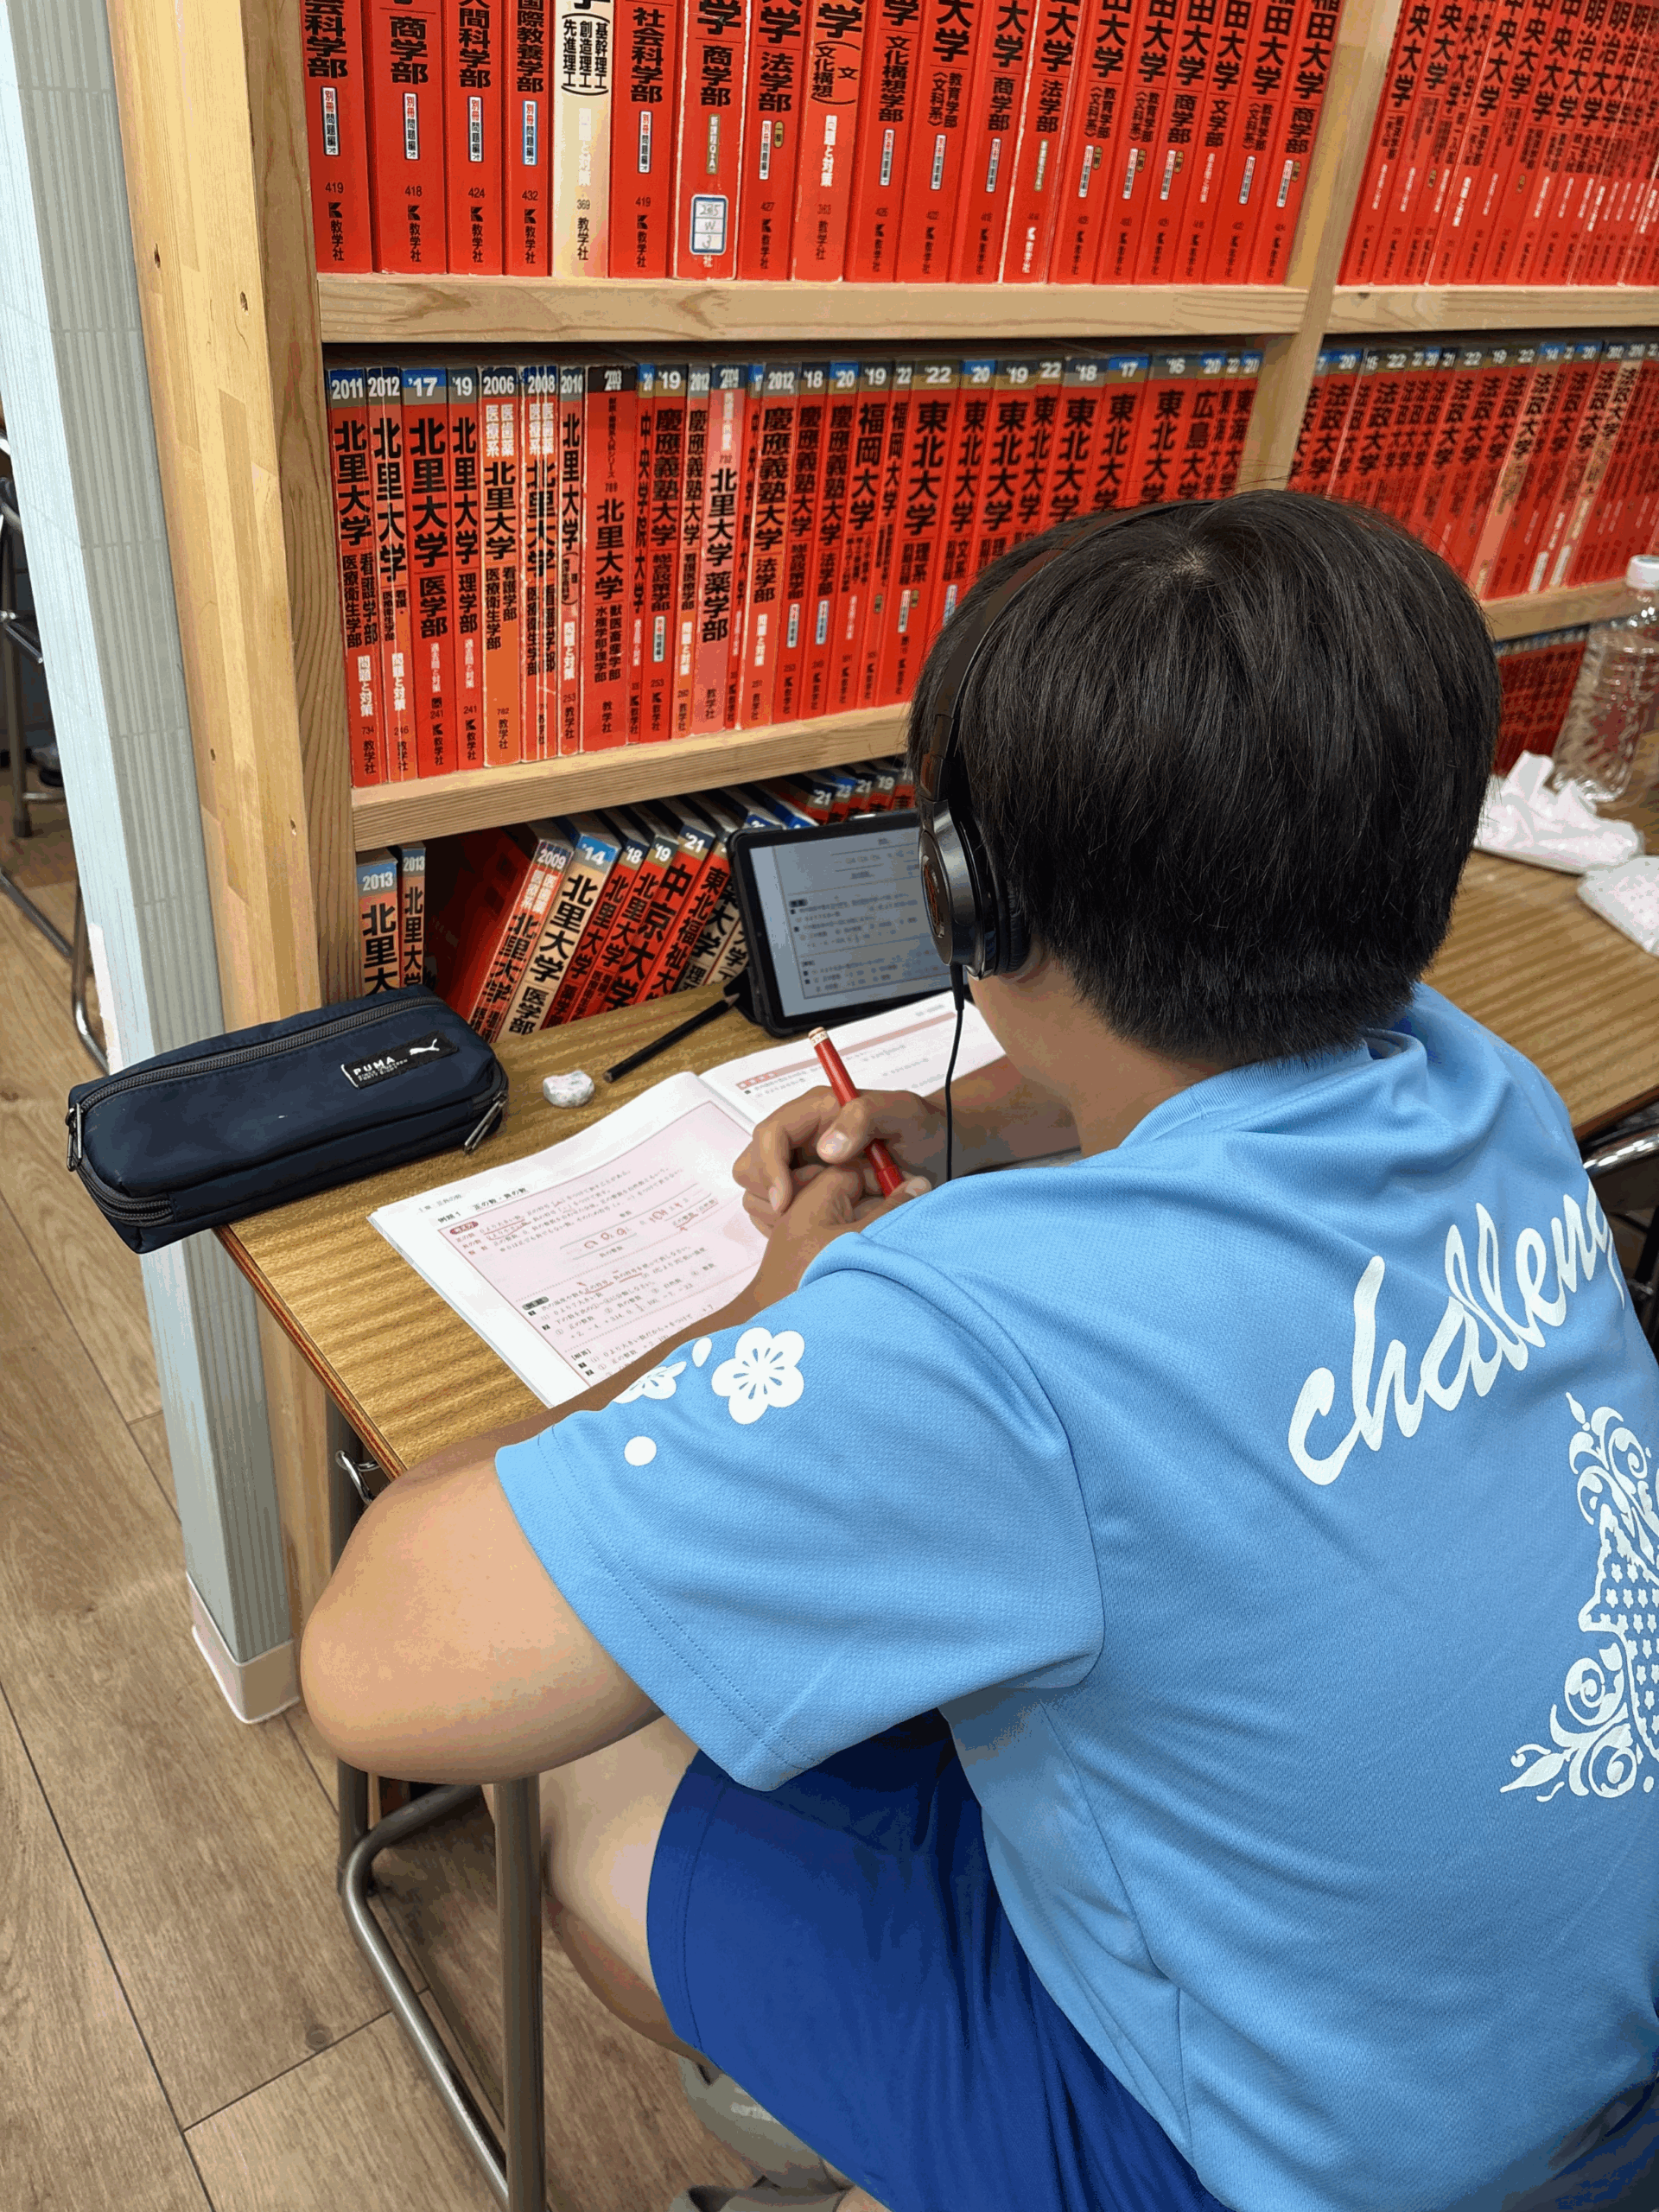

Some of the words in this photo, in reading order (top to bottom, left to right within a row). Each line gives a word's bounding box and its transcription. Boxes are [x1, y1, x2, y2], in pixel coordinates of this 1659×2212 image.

[389, 16, 429, 85] 商学部
[563, 19, 577, 88] 先進理工
[579, 21, 593, 88] 創造理工
[594, 22, 608, 90] 基幹理工
[630, 7, 664, 104] 社会科学部
[1039, 0, 1078, 72] 大学
[1251, 0, 1296, 96] 田大学
[700, 45, 734, 107] 商学部
[758, 51, 794, 113] 法学部
[838, 67, 858, 80] 文
[877, 35, 912, 123] 文化構想学部
[988, 78, 1016, 132] 商学部
[1035, 79, 1064, 133] 法学部
[1167, 94, 1198, 144] 商学部
[1205, 99, 1231, 148] 文学部
[325, 181, 345, 194] 419
[404, 185, 423, 198] 418
[467, 188, 486, 200] 424
[521, 190, 538, 201] 432
[636, 196, 652, 207] 419
[331, 219, 345, 262] 教学社
[410, 223, 422, 263] 教学社
[471, 224, 484, 264] 教学社
[524, 226, 536, 264] 教学社
[577, 217, 589, 260] 教学社
[332, 378, 364, 400] 2011
[368, 376, 401, 397] 2012
[408, 376, 438, 397] '17
[452, 377, 474, 397] '19
[483, 376, 515, 396] 2006
[528, 374, 556, 395] 2008
[658, 371, 682, 390] '19
[1577, 369, 1617, 454] 法政大学
[1356, 381, 1400, 477] 法政大学
[1431, 378, 1474, 472] 法政大学
[1514, 372, 1554, 461] 法政大学
[334, 419, 373, 547] 北里大学
[453, 416, 479, 565] 北里大学
[563, 413, 581, 551] 北里大学
[849, 402, 887, 531] 福岡大学
[904, 399, 950, 537] 東北大学
[948, 399, 988, 532] 東北大学
[982, 400, 1030, 532] 東北大学
[1016, 395, 1058, 524] 東北大学
[1048, 396, 1098, 524] 東北大学
[372, 417, 408, 582] 北里大学
[409, 417, 449, 569] 北里大学
[483, 461, 517, 561] 北里大学
[526, 459, 557, 578] 北里大学
[706, 467, 738, 568] 北里大学
[594, 498, 625, 601] 北里大学
[753, 557, 777, 604] 法学部
[419, 575, 448, 639] 医学部
[458, 572, 478, 634] 理学部
[702, 570, 734, 644] 薬学部
[462, 705, 478, 715] 241
[601, 700, 613, 734] 教学社
[362, 871, 394, 892] 2013
[403, 855, 425, 873] 2013
[537, 848, 567, 870] 2009
[582, 842, 606, 866] '14
[626, 845, 644, 864] '18
[654, 842, 673, 862] '19
[360, 902, 398, 997] 北里大
[528, 874, 598, 984] 北里大学
[569, 874, 629, 980] 北里大学
[601, 872, 659, 968] 北里大学
[605, 864, 693, 1011] 中京大学
[483, 912, 542, 1007] 北里大学
[508, 985, 549, 1037] 医学部
[353, 1055, 397, 1077] PUMA
